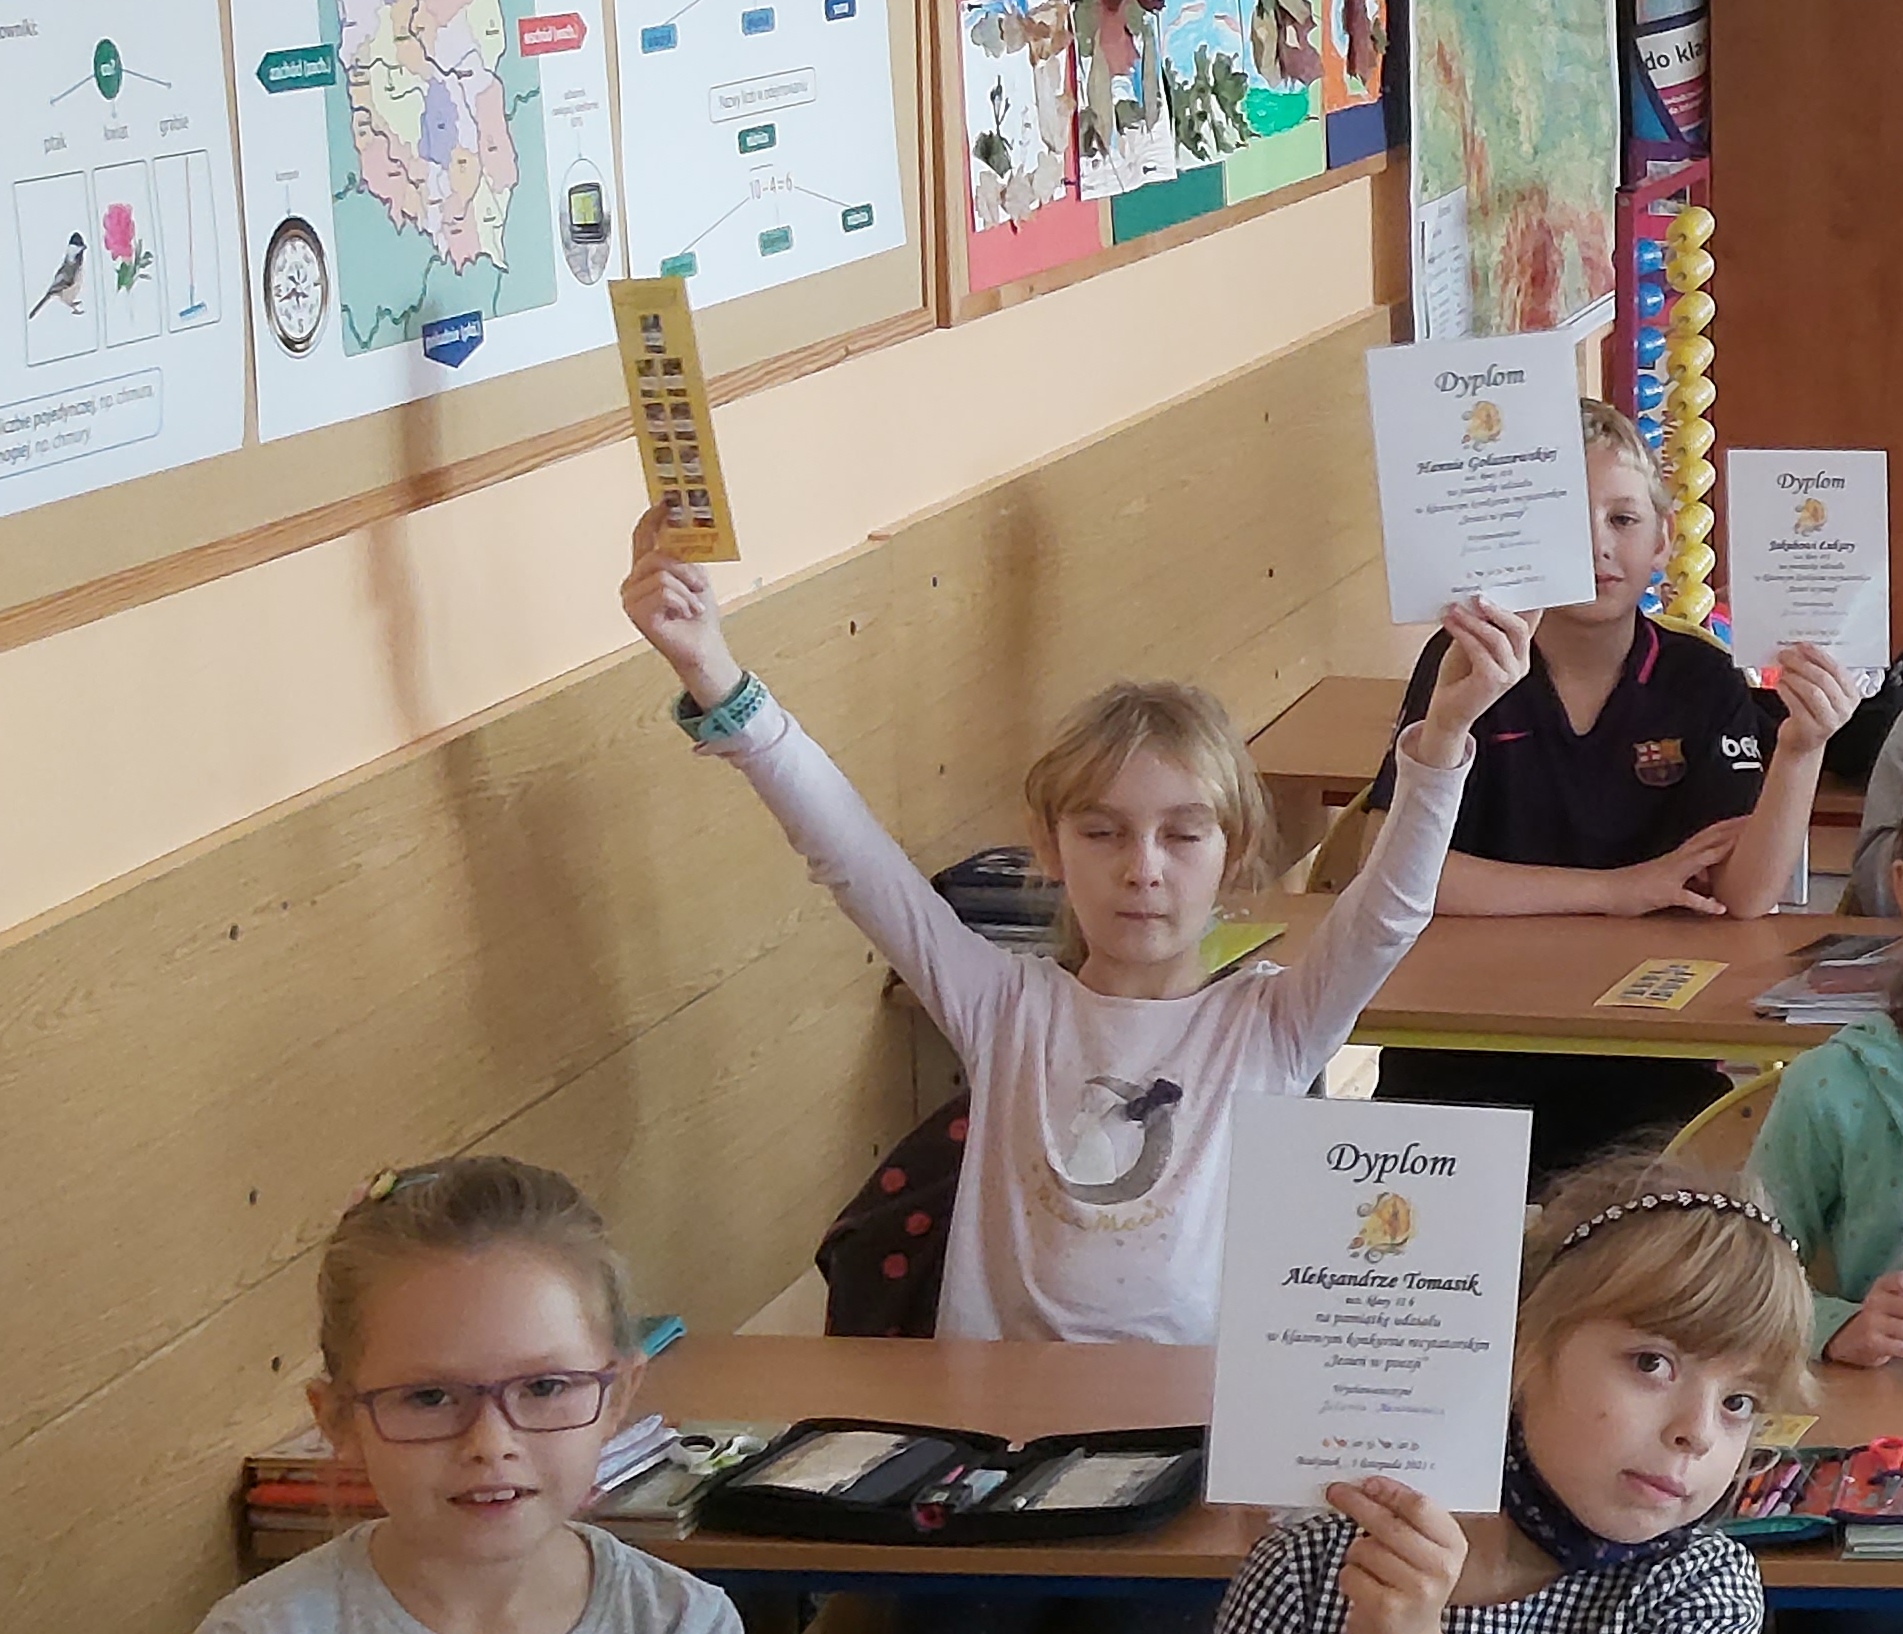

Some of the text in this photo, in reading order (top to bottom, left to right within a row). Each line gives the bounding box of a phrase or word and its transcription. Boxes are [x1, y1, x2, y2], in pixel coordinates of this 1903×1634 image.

[1645, 51, 1671, 70] do
[1434, 363, 1525, 398] Dyplom
[1776, 470, 1846, 495] Dyplom
[1326, 1142, 1456, 1184] Dyplom
[1281, 1266, 1483, 1296] Aleksandrze Tomasik
